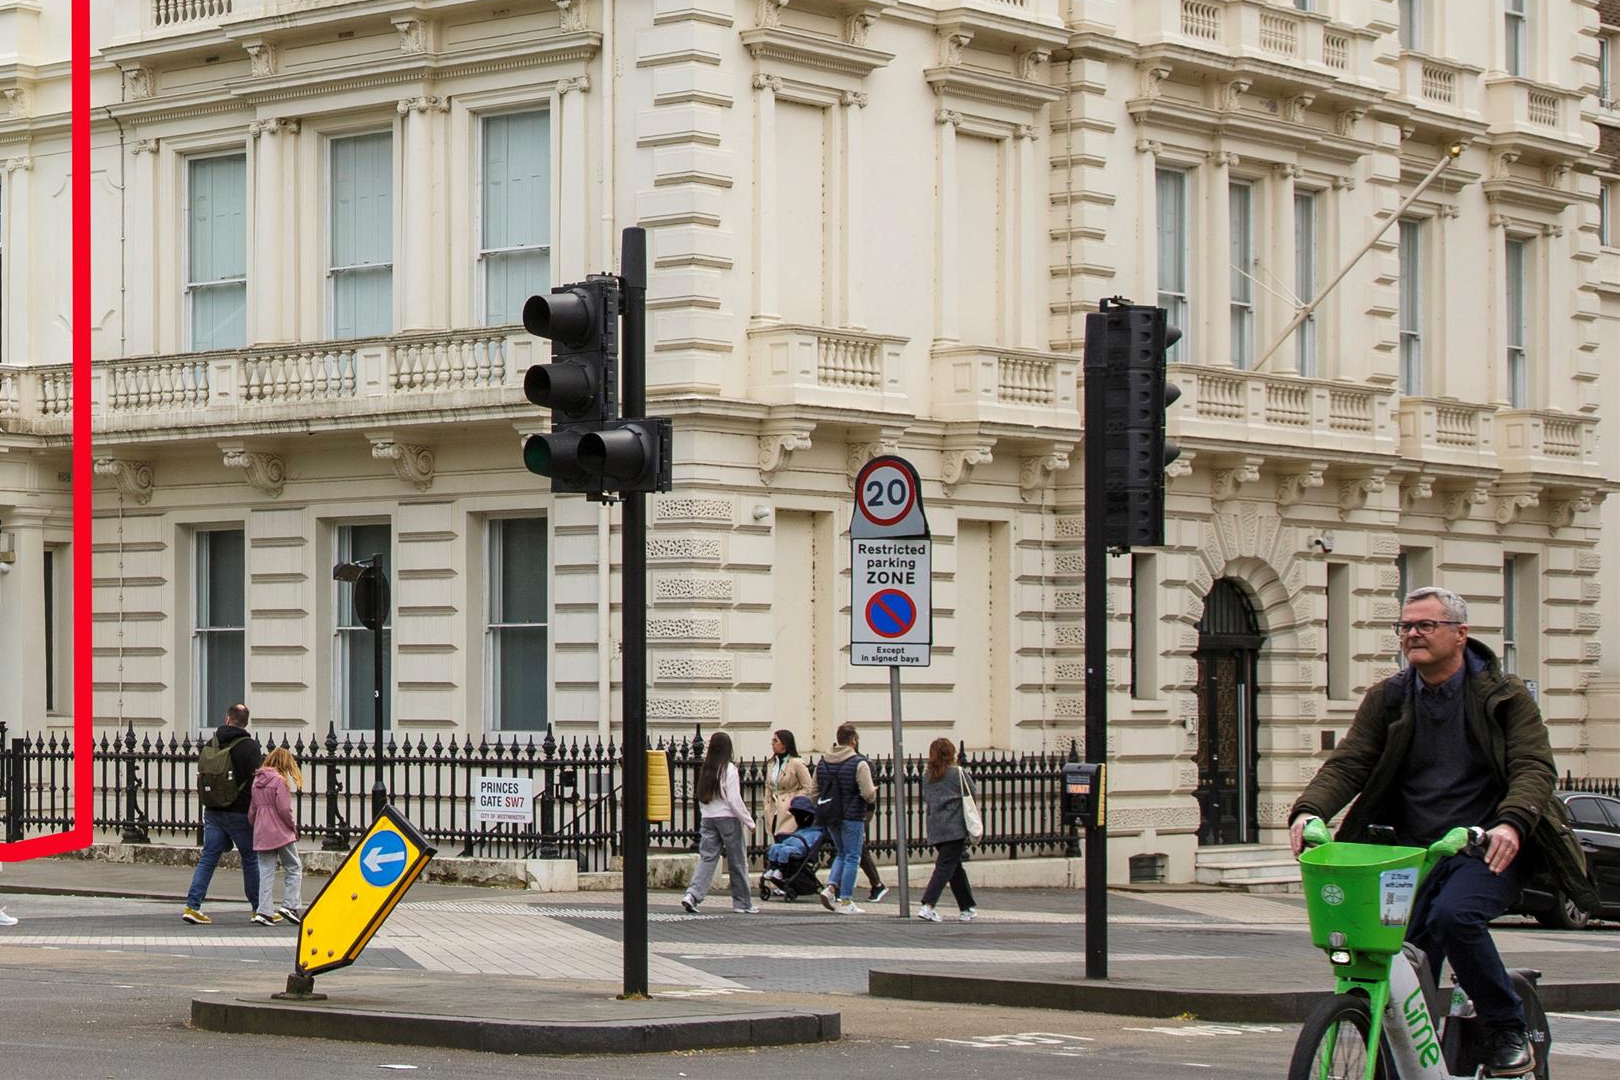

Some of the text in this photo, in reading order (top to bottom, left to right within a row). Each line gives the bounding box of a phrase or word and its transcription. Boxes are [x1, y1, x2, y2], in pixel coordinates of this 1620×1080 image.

[867, 479, 907, 507] 20
[858, 544, 926, 555] Restricted
[867, 557, 916, 570] parking
[866, 571, 916, 585] ZONE
[876, 646, 905, 655] Except
[871, 655, 898, 663] signed
[900, 655, 920, 663] bays
[480, 781, 519, 794] PRINCES
[480, 796, 525, 808] GATE SW7
[1403, 987, 1440, 1069] Lime
